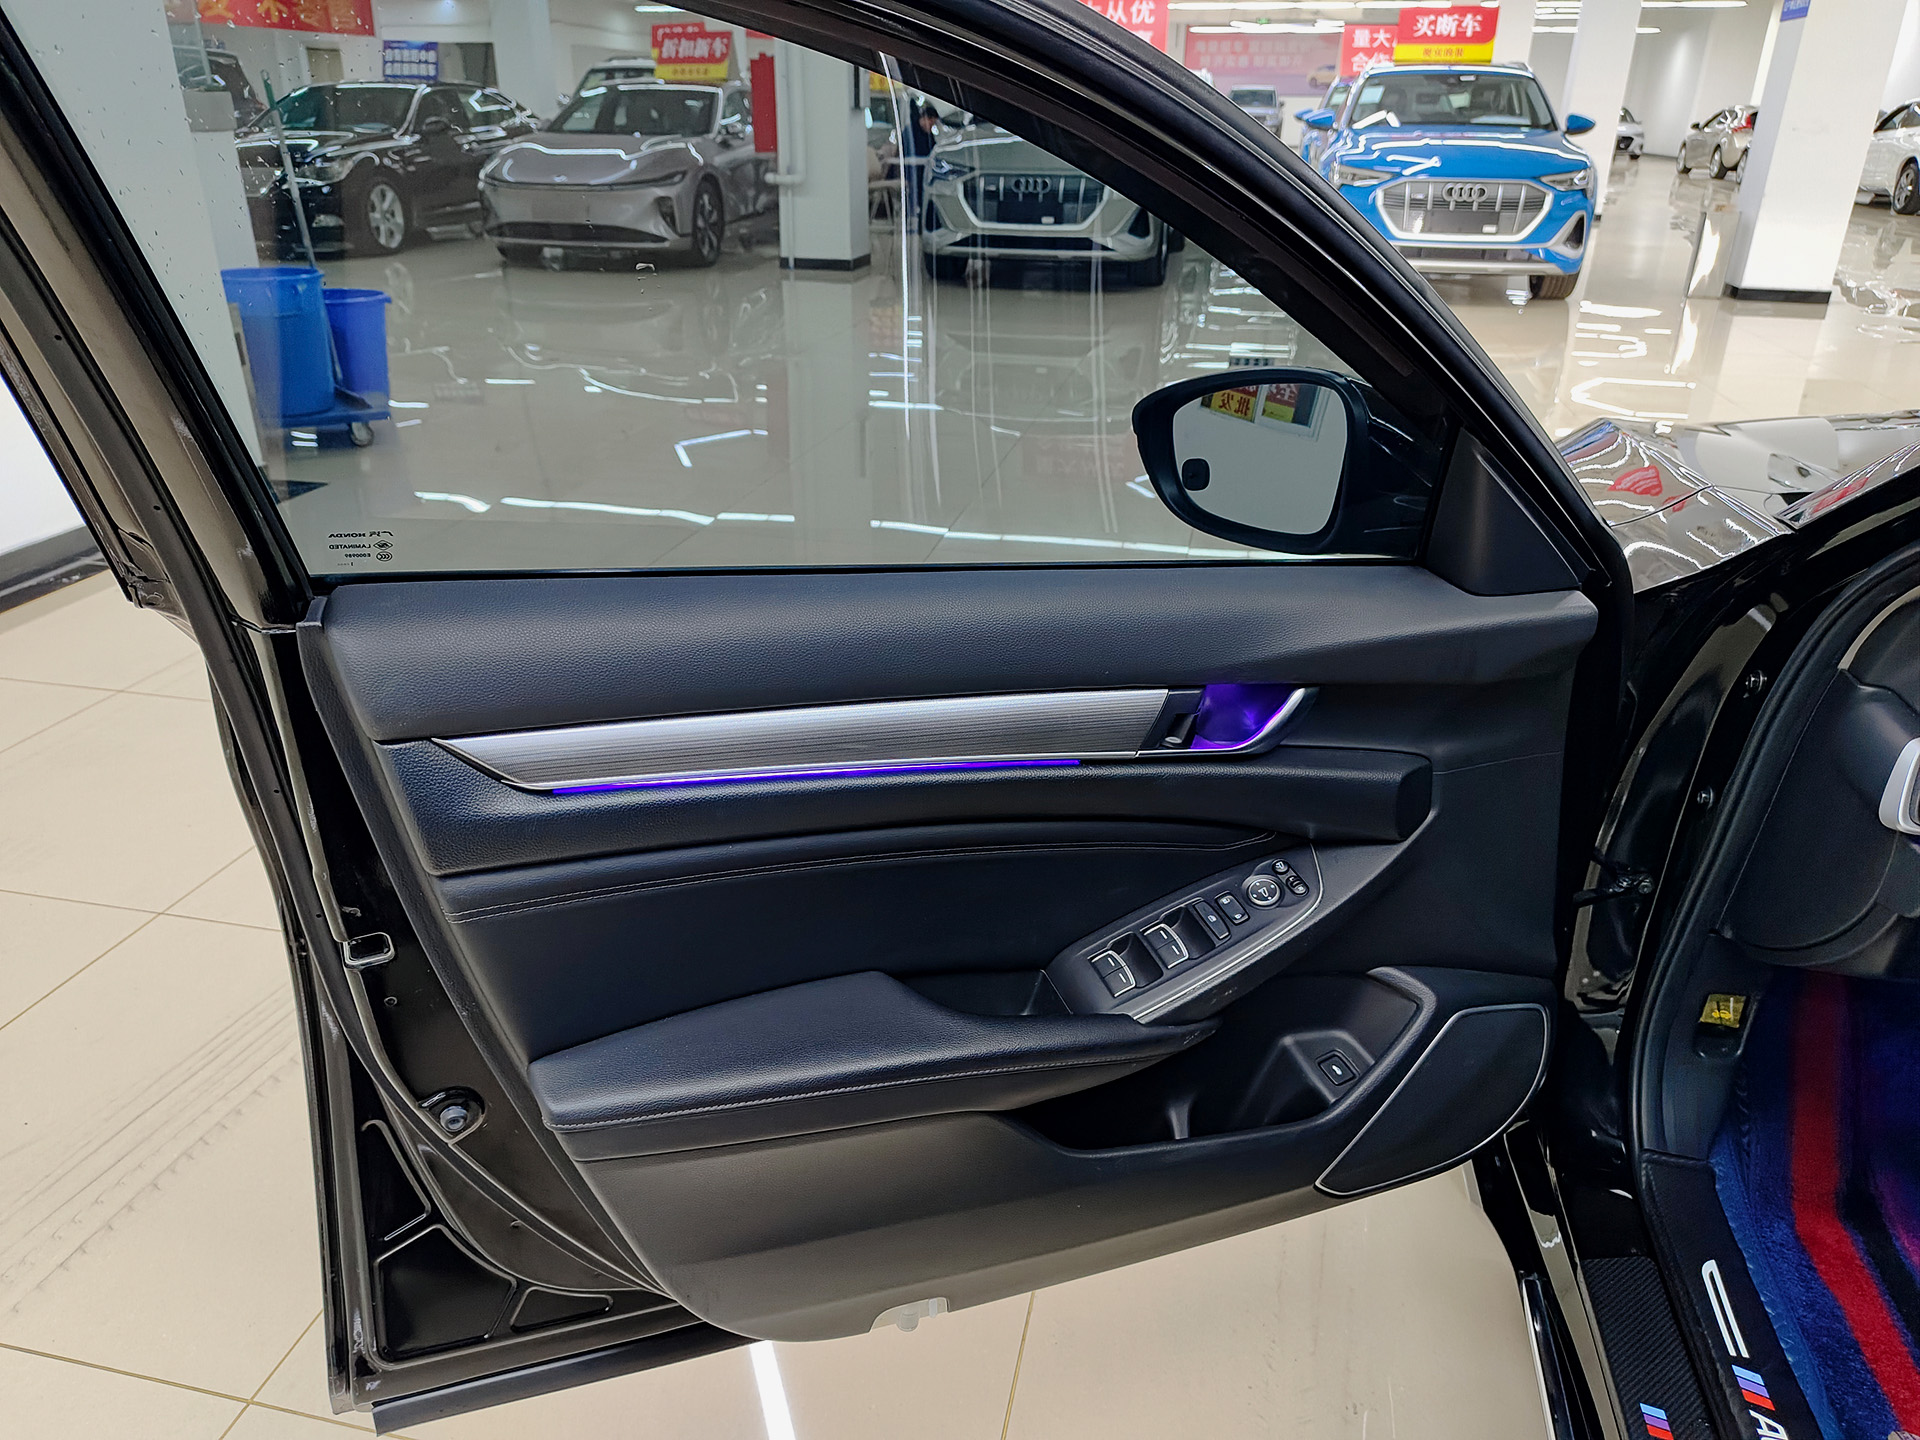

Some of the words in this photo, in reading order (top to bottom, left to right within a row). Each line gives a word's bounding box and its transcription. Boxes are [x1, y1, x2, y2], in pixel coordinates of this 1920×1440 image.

[1413, 13, 1483, 38] 买断车
[1352, 29, 1397, 48] 量大
[1748, 1409, 1789, 1440] A
